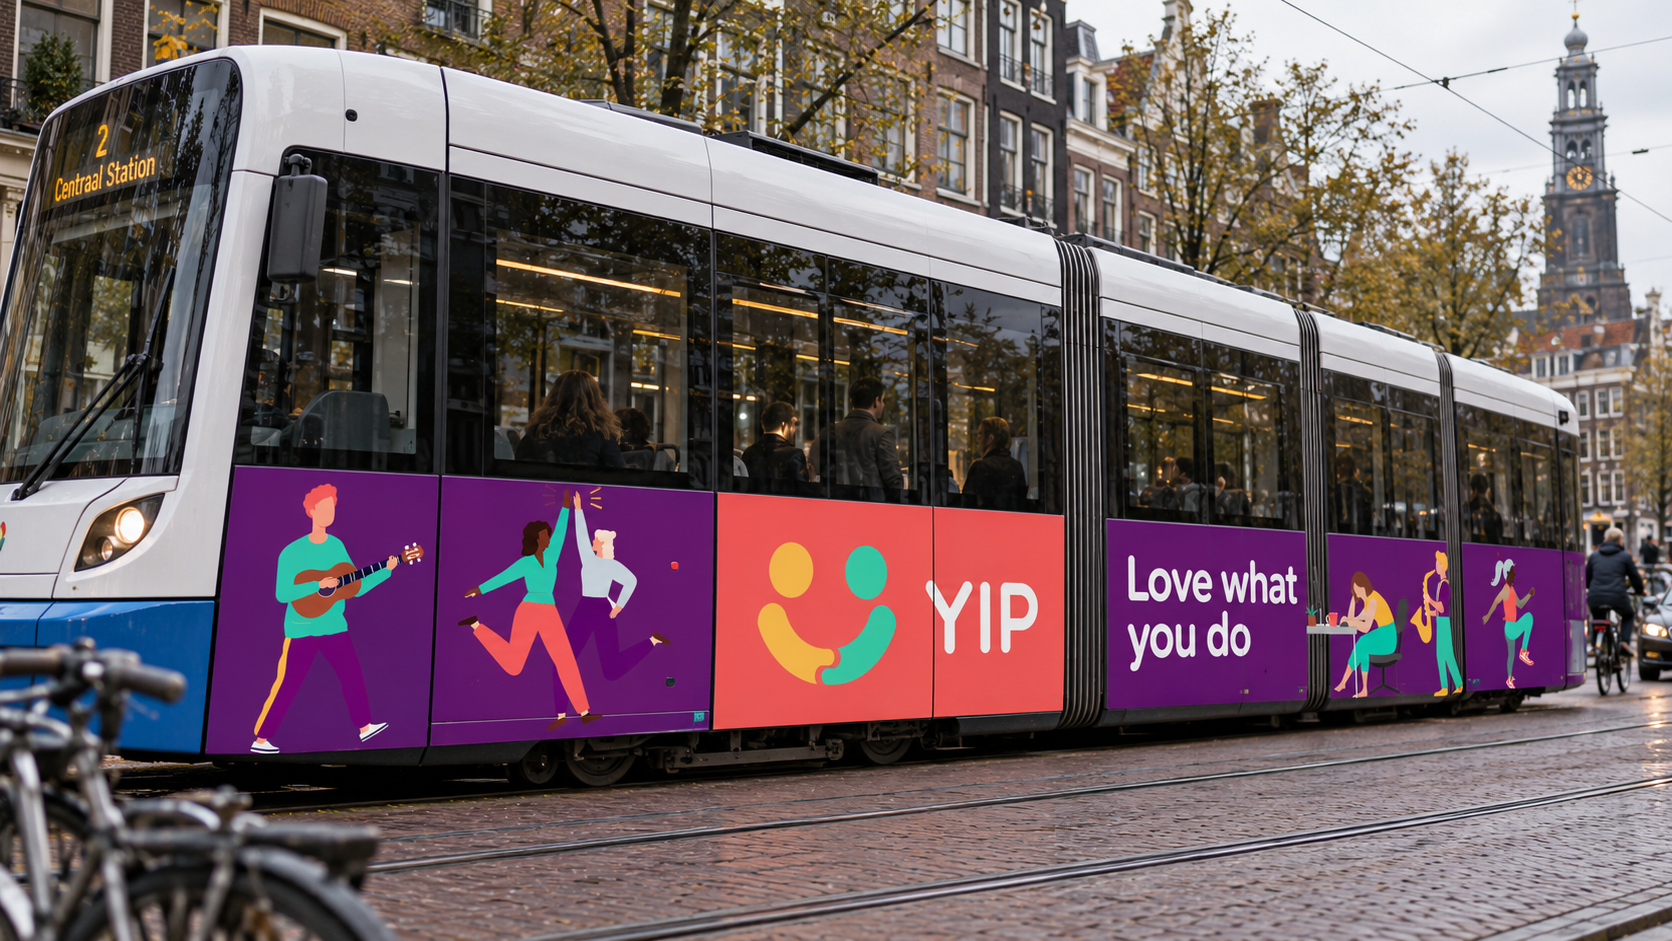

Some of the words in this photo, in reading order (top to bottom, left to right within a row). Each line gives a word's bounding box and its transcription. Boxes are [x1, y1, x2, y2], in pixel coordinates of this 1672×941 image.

[96, 124, 109, 158] 2
[55, 164, 104, 202] Centraal
[106, 154, 156, 187] Station
[1127, 555, 1213, 603] Love
[1220, 559, 1298, 605] what
[925, 580, 1039, 655] YIP
[1127, 623, 1196, 672] you
[1206, 610, 1252, 657] do
